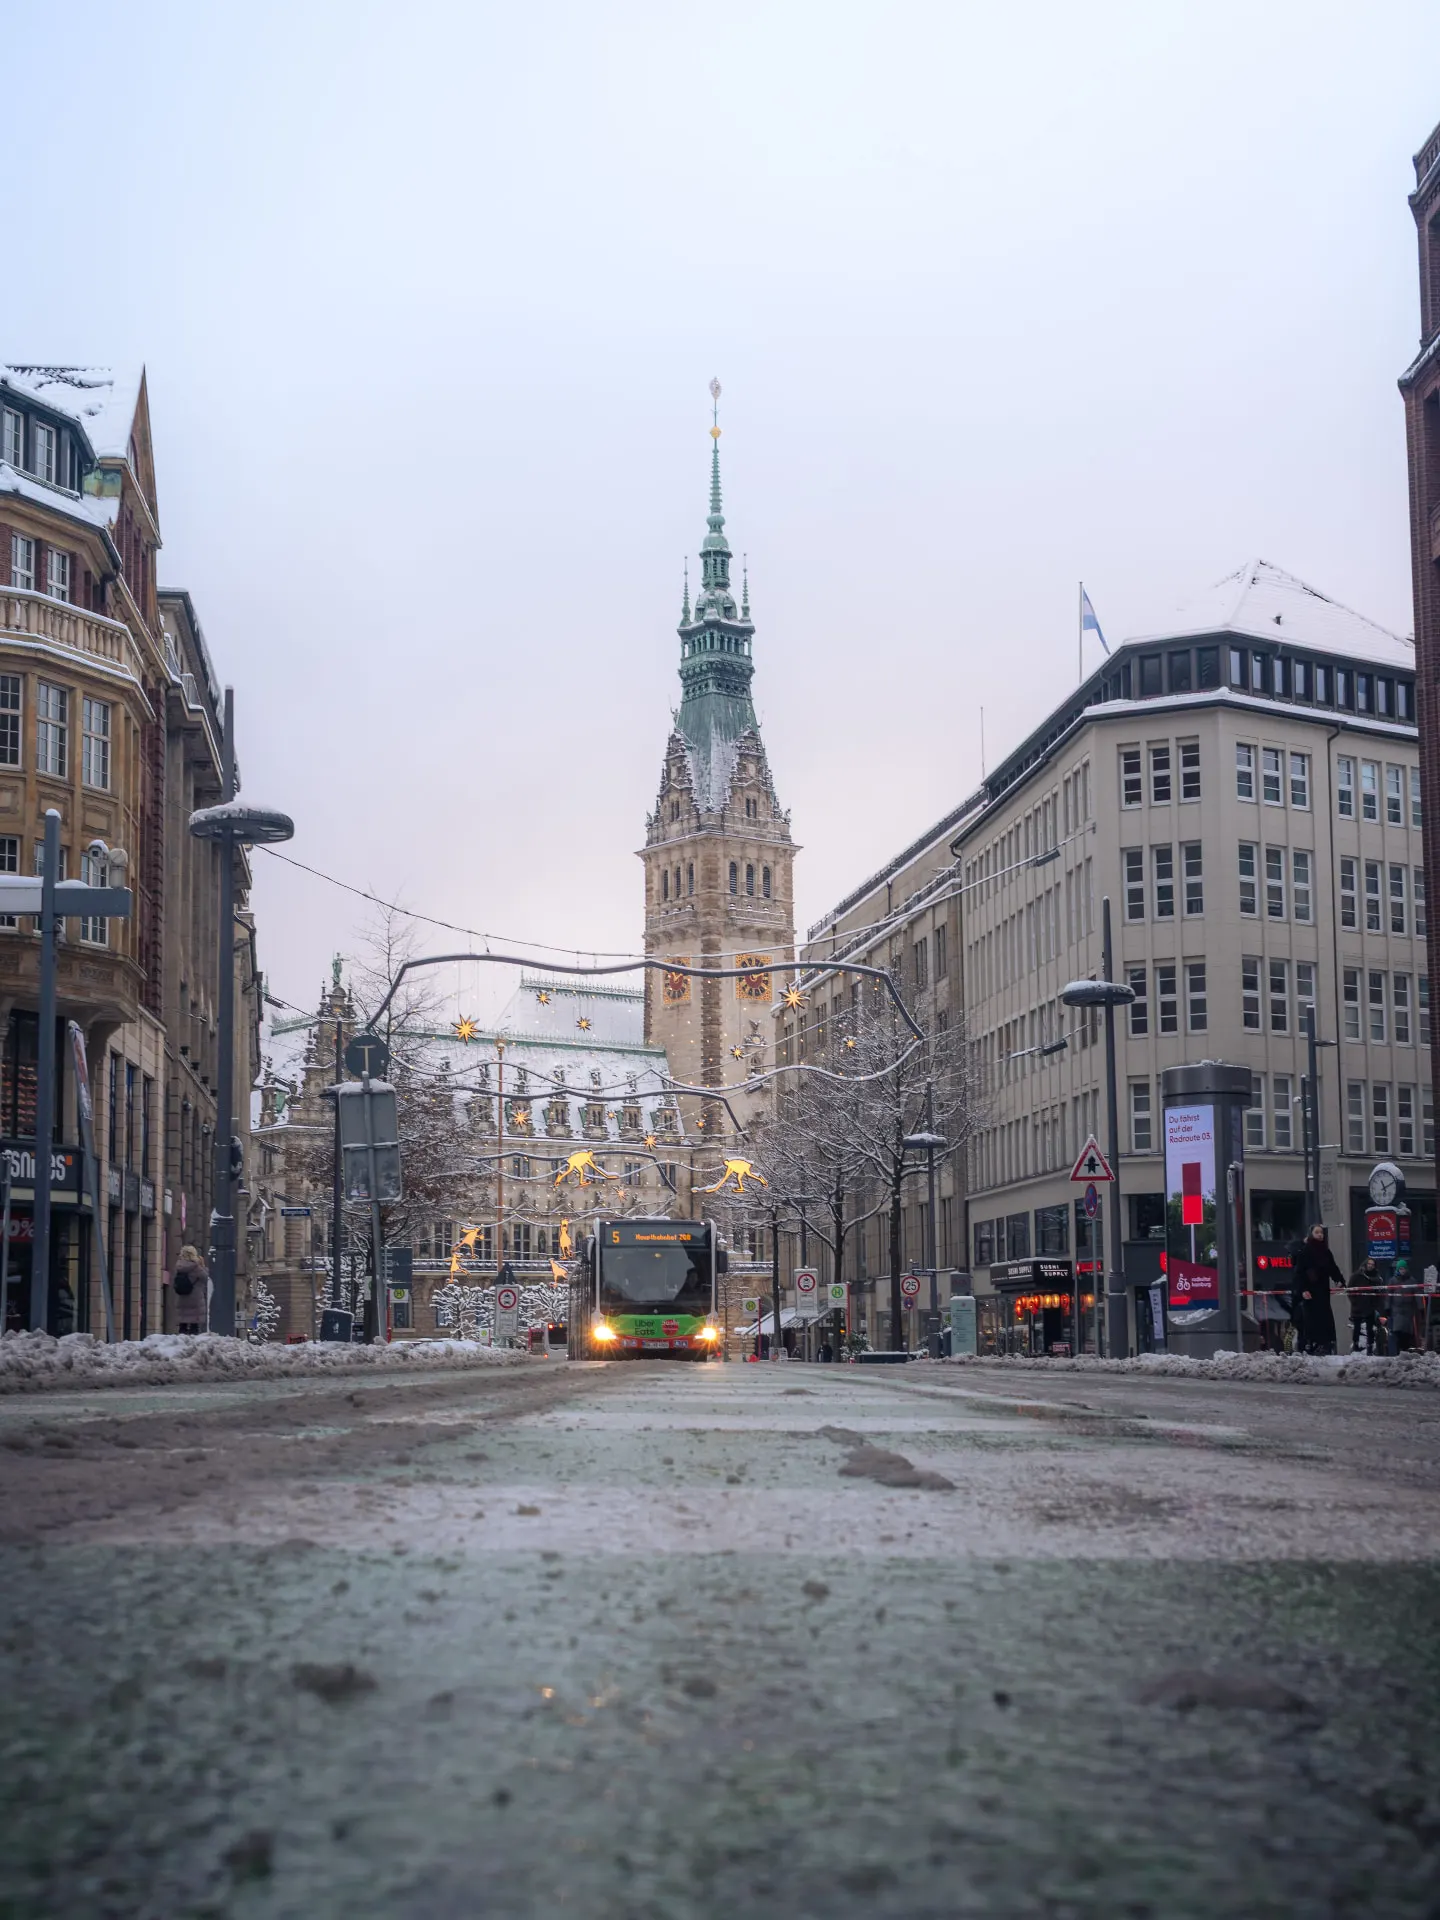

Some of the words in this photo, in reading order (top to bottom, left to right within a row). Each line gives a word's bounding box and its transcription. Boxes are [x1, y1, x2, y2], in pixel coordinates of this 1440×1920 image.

[1169, 1116, 1179, 1124] Du
[1169, 1125, 1181, 1133] auf
[1182, 1123, 1193, 1132] der
[1169, 1135, 1200, 1144] Radroute
[612, 1230, 620, 1244] 5
[905, 1281, 917, 1291] 25
[634, 1319, 656, 1327] Uber
[634, 1327, 656, 1336] Eats
